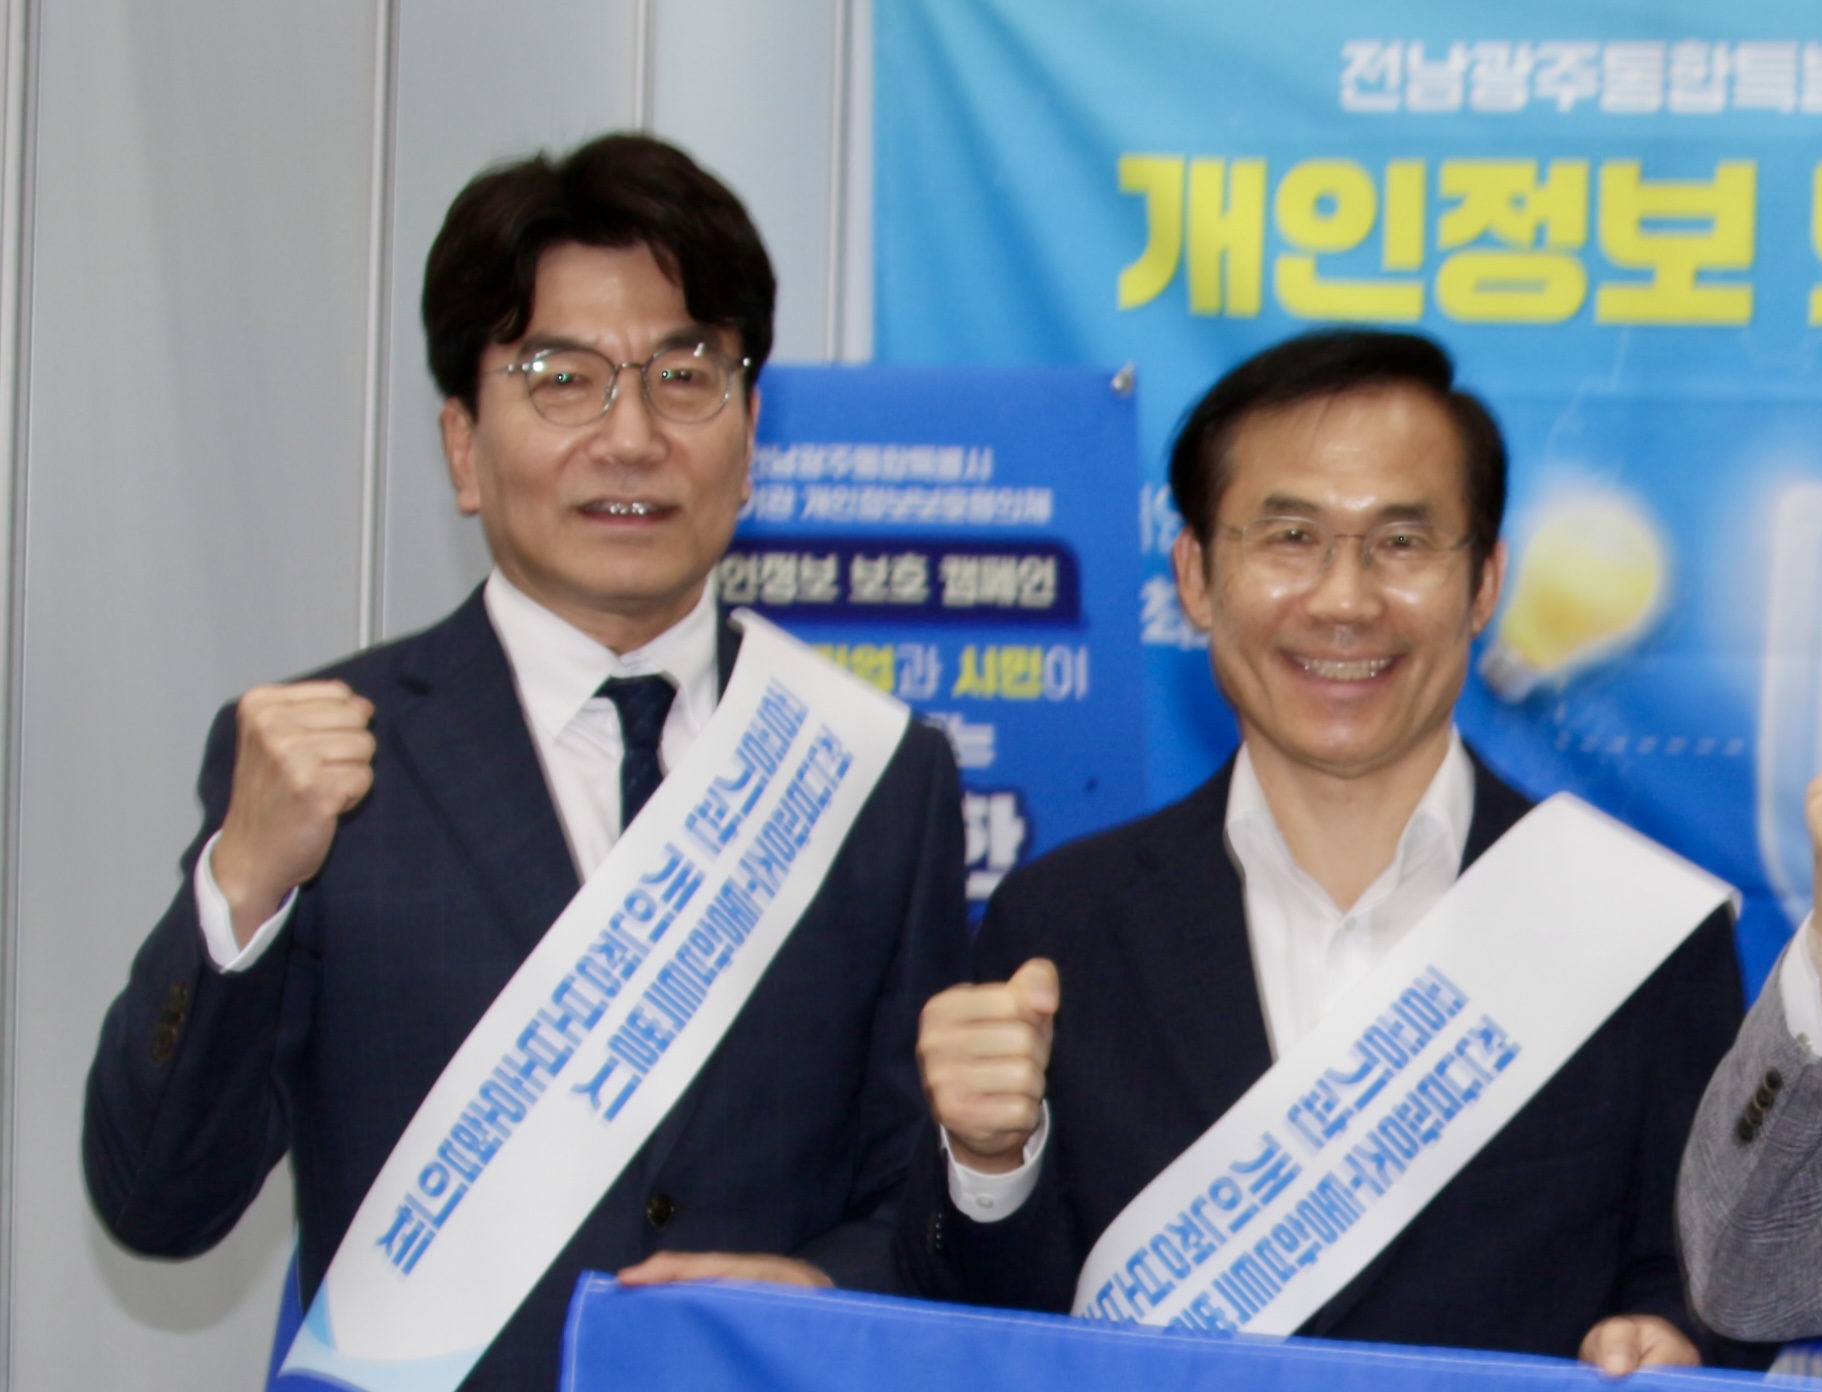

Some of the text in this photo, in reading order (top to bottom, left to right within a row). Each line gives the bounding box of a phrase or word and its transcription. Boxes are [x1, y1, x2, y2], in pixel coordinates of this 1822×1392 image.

[1117, 153, 1757, 326] 개인정보
[714, 553, 1058, 608] 인정보 보호 캠페인
[952, 645, 1090, 700] 시민이
[373, 676, 810, 1275] 공공기관 개인정보보호협의체
[570, 727, 854, 1122] 전남광주통합특별시
[1287, 963, 1470, 1154] 공공기관
[1164, 1013, 1522, 1338] 전남광주통합특별
